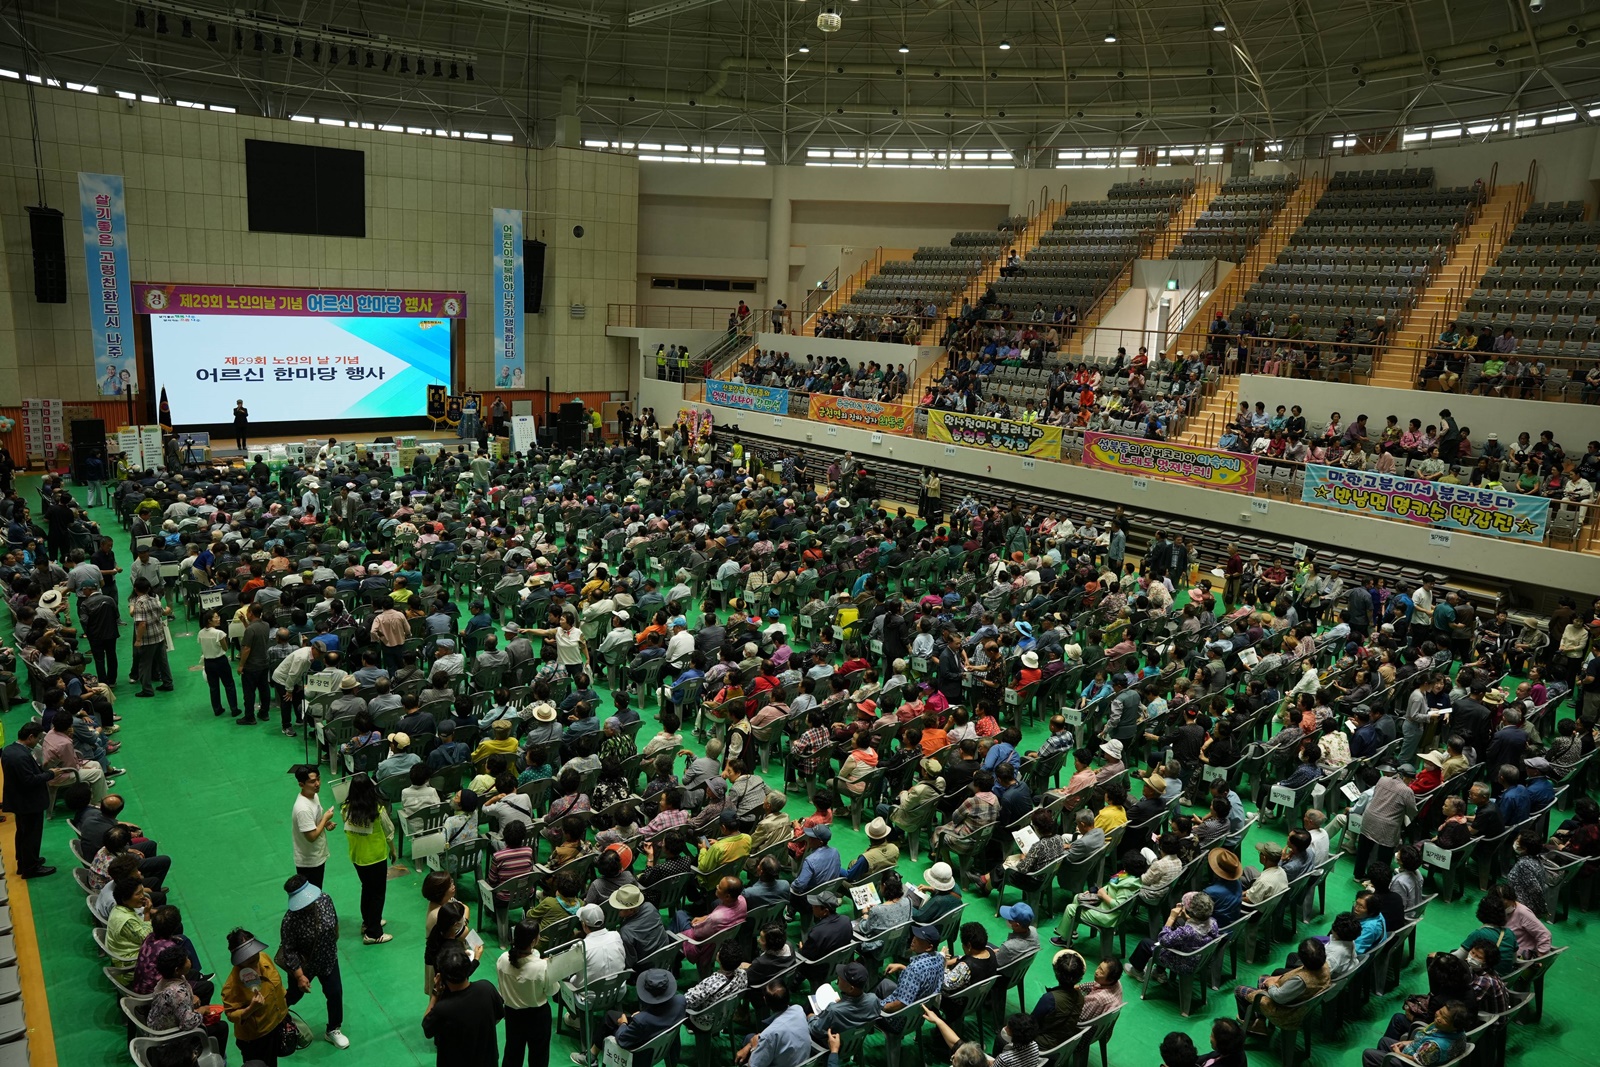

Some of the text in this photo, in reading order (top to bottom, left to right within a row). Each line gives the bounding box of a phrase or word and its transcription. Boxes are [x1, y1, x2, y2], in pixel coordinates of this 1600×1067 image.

[94, 194, 122, 357] 살기좋은 고령친화도시 나주
[502, 224, 515, 358] 어르신이 행복해야 나주가 행복합니다
[150, 294, 162, 308] 경
[180, 293, 434, 313] 제29회 노인의날 기념 어르신 한마당 행사
[224, 356, 359, 366] 제29회 노인의 날 기념
[196, 366, 386, 382] 어르신 한마당 행사
[730, 394, 754, 405] 사나이
[944, 413, 1044, 438] 완사천에서 불러본다
[1098, 438, 1240, 472] 성북동의 실버코리아 이숙자!
[1120, 453, 1155, 469] 노래도
[1328, 470, 1516, 509] 마한고분에서 불러본다
[1333, 485, 1388, 511] 반남면
[1451, 504, 1515, 532] 박갑진
[1431, 534, 1450, 542] 빛가람동
[202, 596, 220, 605] 반남면
[309, 679, 330, 688] 동강면
[1273, 791, 1292, 802] 빛가람동
[1426, 851, 1447, 863] 빛가람동
